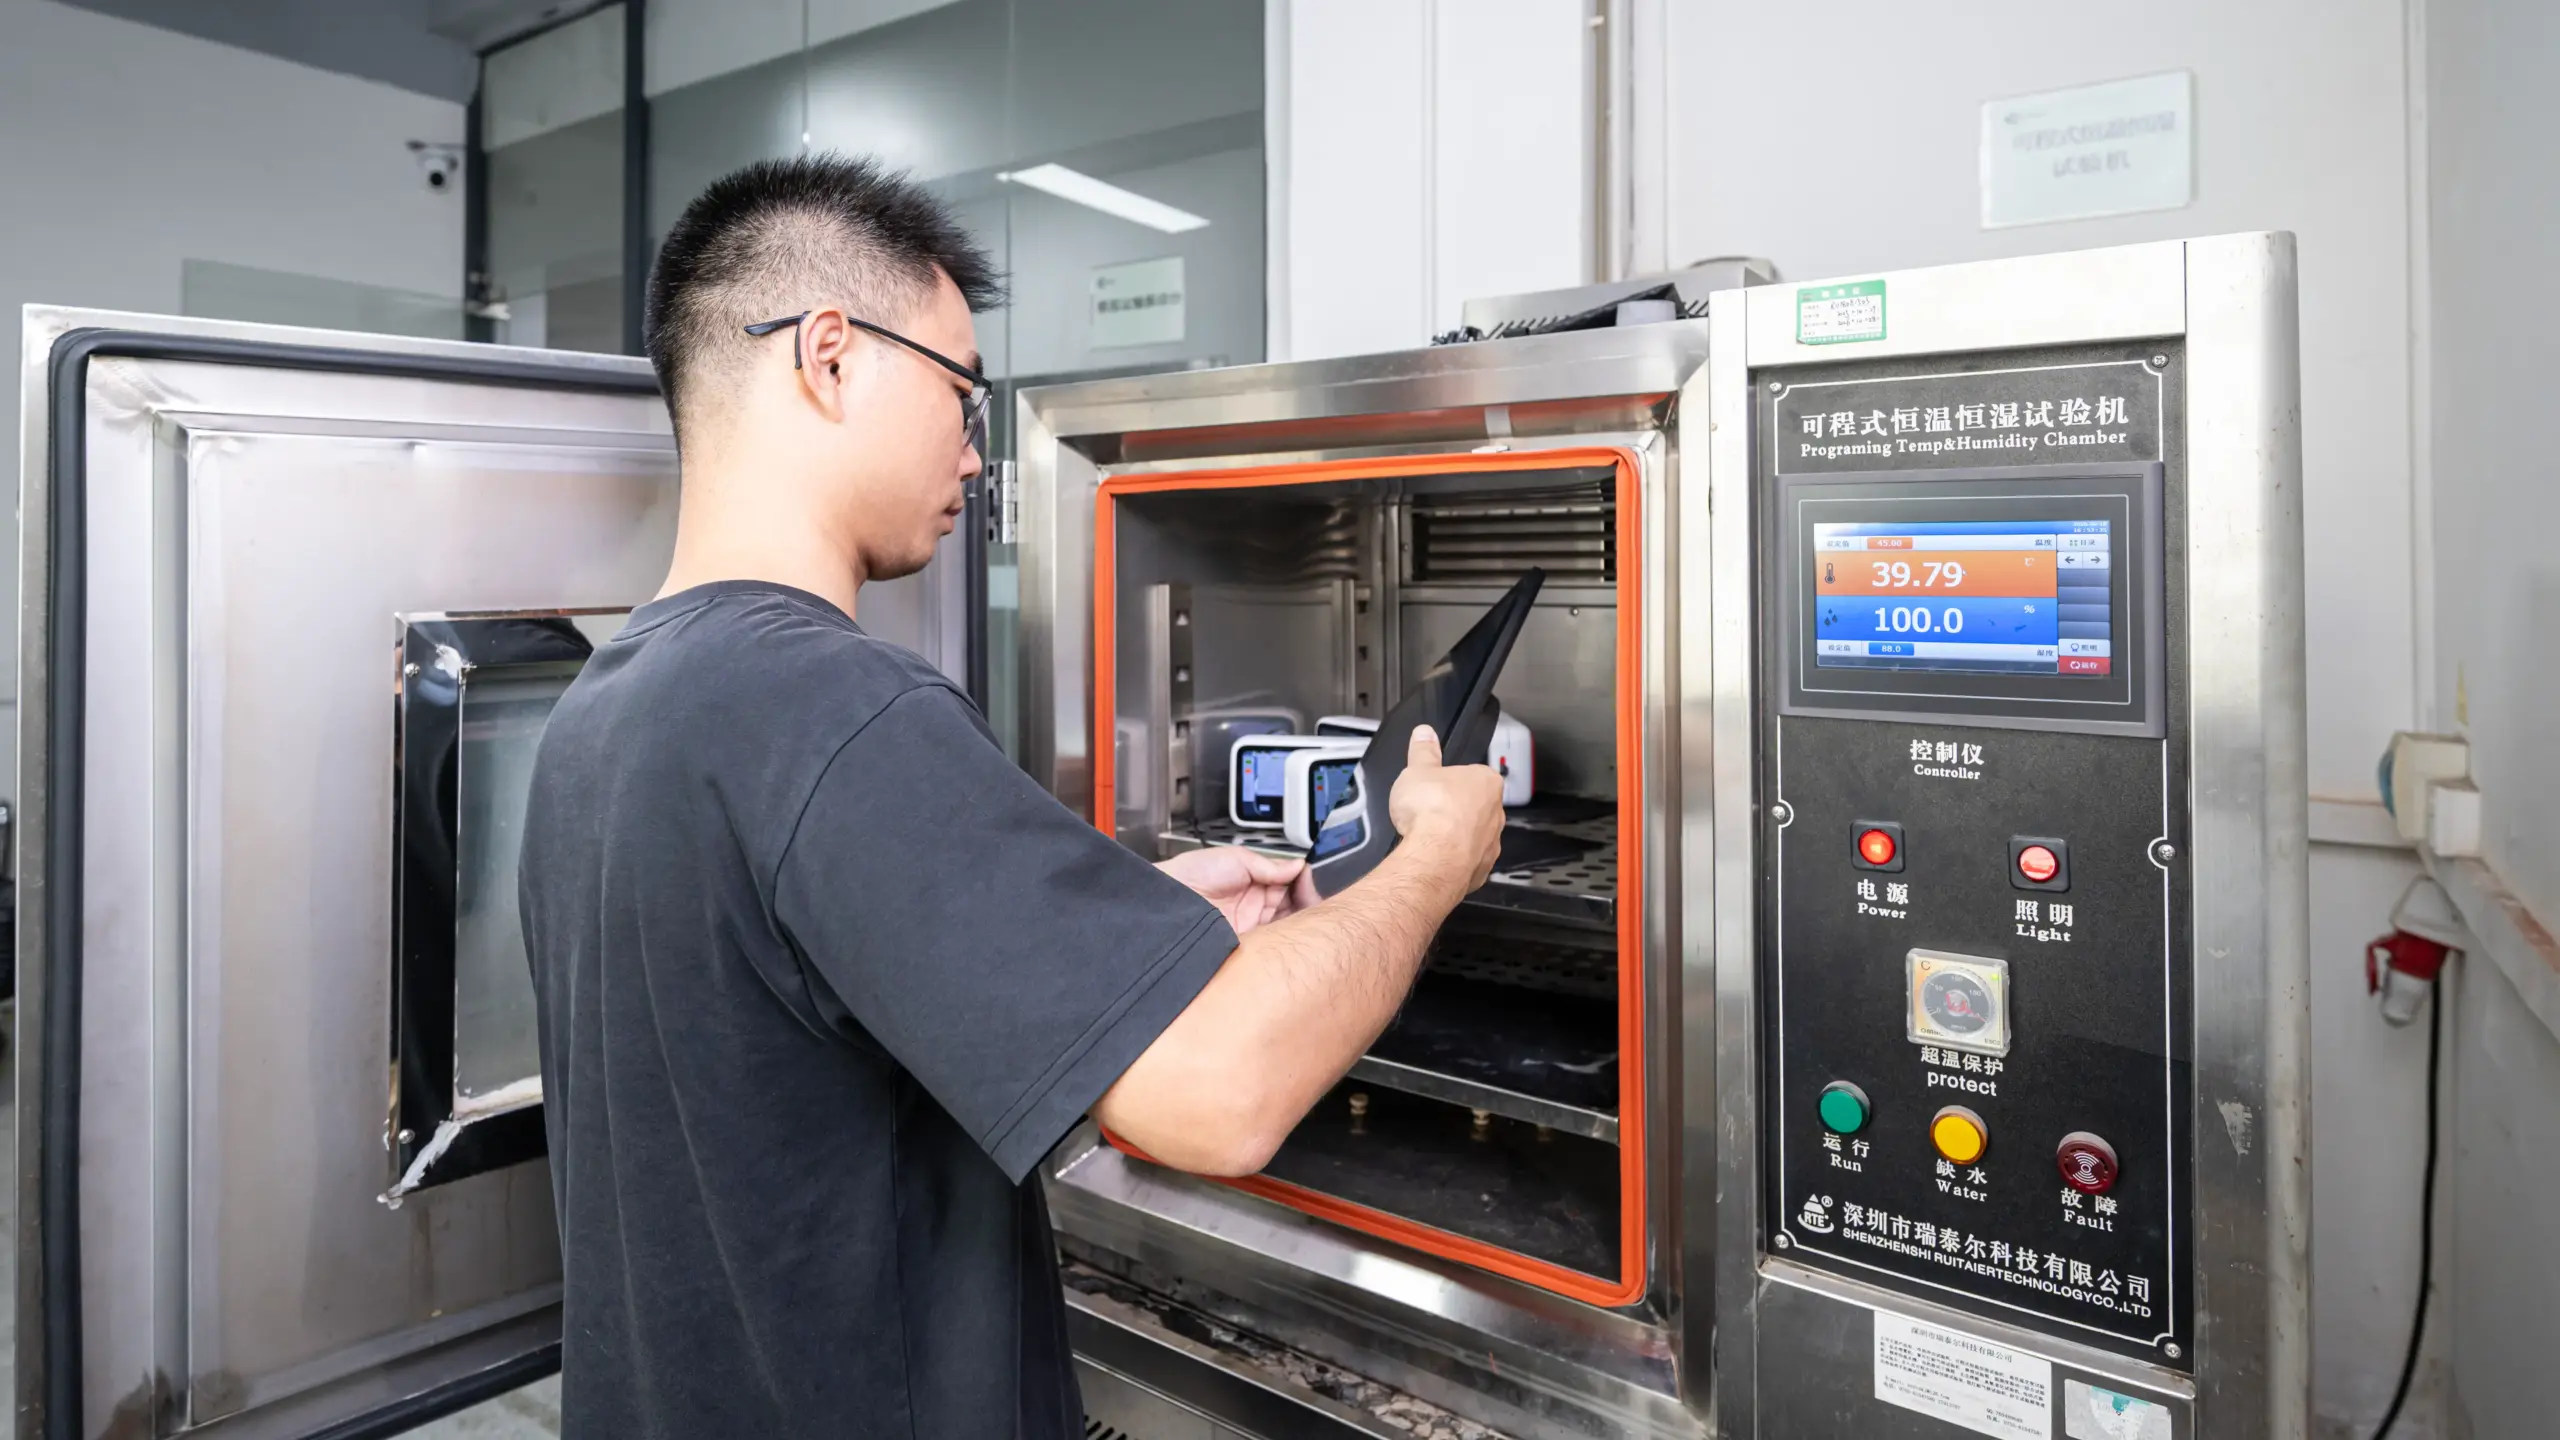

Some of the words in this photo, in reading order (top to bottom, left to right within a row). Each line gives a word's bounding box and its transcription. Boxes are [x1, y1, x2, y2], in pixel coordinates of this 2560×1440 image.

[1800, 396, 2129, 439] 可程式恒温恒湿试验机
[1800, 441, 1892, 459] Programing
[1896, 435, 2038, 455] Temp&Humidity
[2044, 429, 2127, 447] Chamber
[1872, 561, 1963, 588] 39.79
[1874, 607, 1963, 634] 100.0
[2023, 604, 2036, 614] %
[1909, 739, 1985, 766] 控制仪
[1913, 763, 1981, 780] Controller
[1857, 878, 1909, 905] 电源
[1857, 902, 1907, 919] Power
[2014, 899, 2074, 927] 照明
[2015, 923, 2071, 942] Light
[1920, 1045, 2004, 1077] 超温保护
[1927, 1071, 1997, 1097] protect
[1822, 1131, 1870, 1158] 运行
[1830, 1153, 1862, 1173] Run
[1936, 1158, 1988, 1185] 缺水
[1936, 1178, 1988, 1202] Water
[2060, 1187, 2118, 1216] 故障
[2063, 1208, 2113, 1232] Fault
[1843, 1200, 2150, 1303] 深圳市瑞泰尔科技有限公司
[1842, 1227, 1932, 1261] SHENZHENSHI
[1933, 1251, 2152, 1319] RUITAIERTECHNOLOGYCO.,LTD
[1911, 1326, 2013, 1363] 深圳市瑞泰尔科技有限公司
